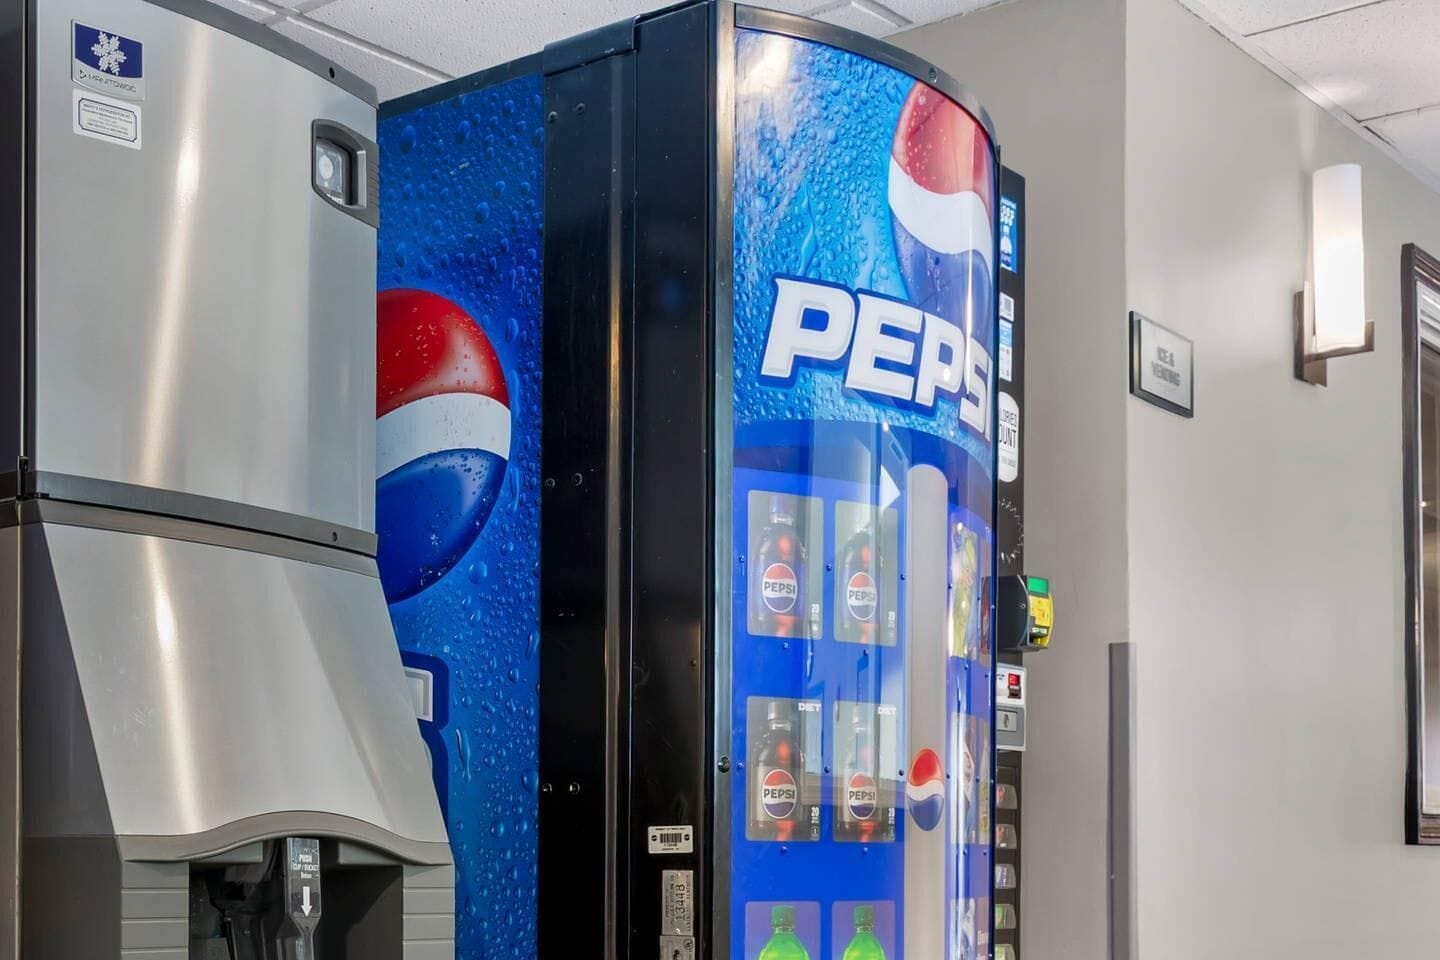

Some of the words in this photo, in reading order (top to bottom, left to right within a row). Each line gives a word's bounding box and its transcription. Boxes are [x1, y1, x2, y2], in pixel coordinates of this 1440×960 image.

[761, 278, 993, 440] PEPSI
[764, 582, 796, 595] PEPSI
[849, 590, 876, 602] PEPSI
[798, 702, 822, 712] DIET
[763, 788, 796, 799] PEPSI
[849, 790, 876, 801] PEPSI
[675, 883, 686, 921] 13448
